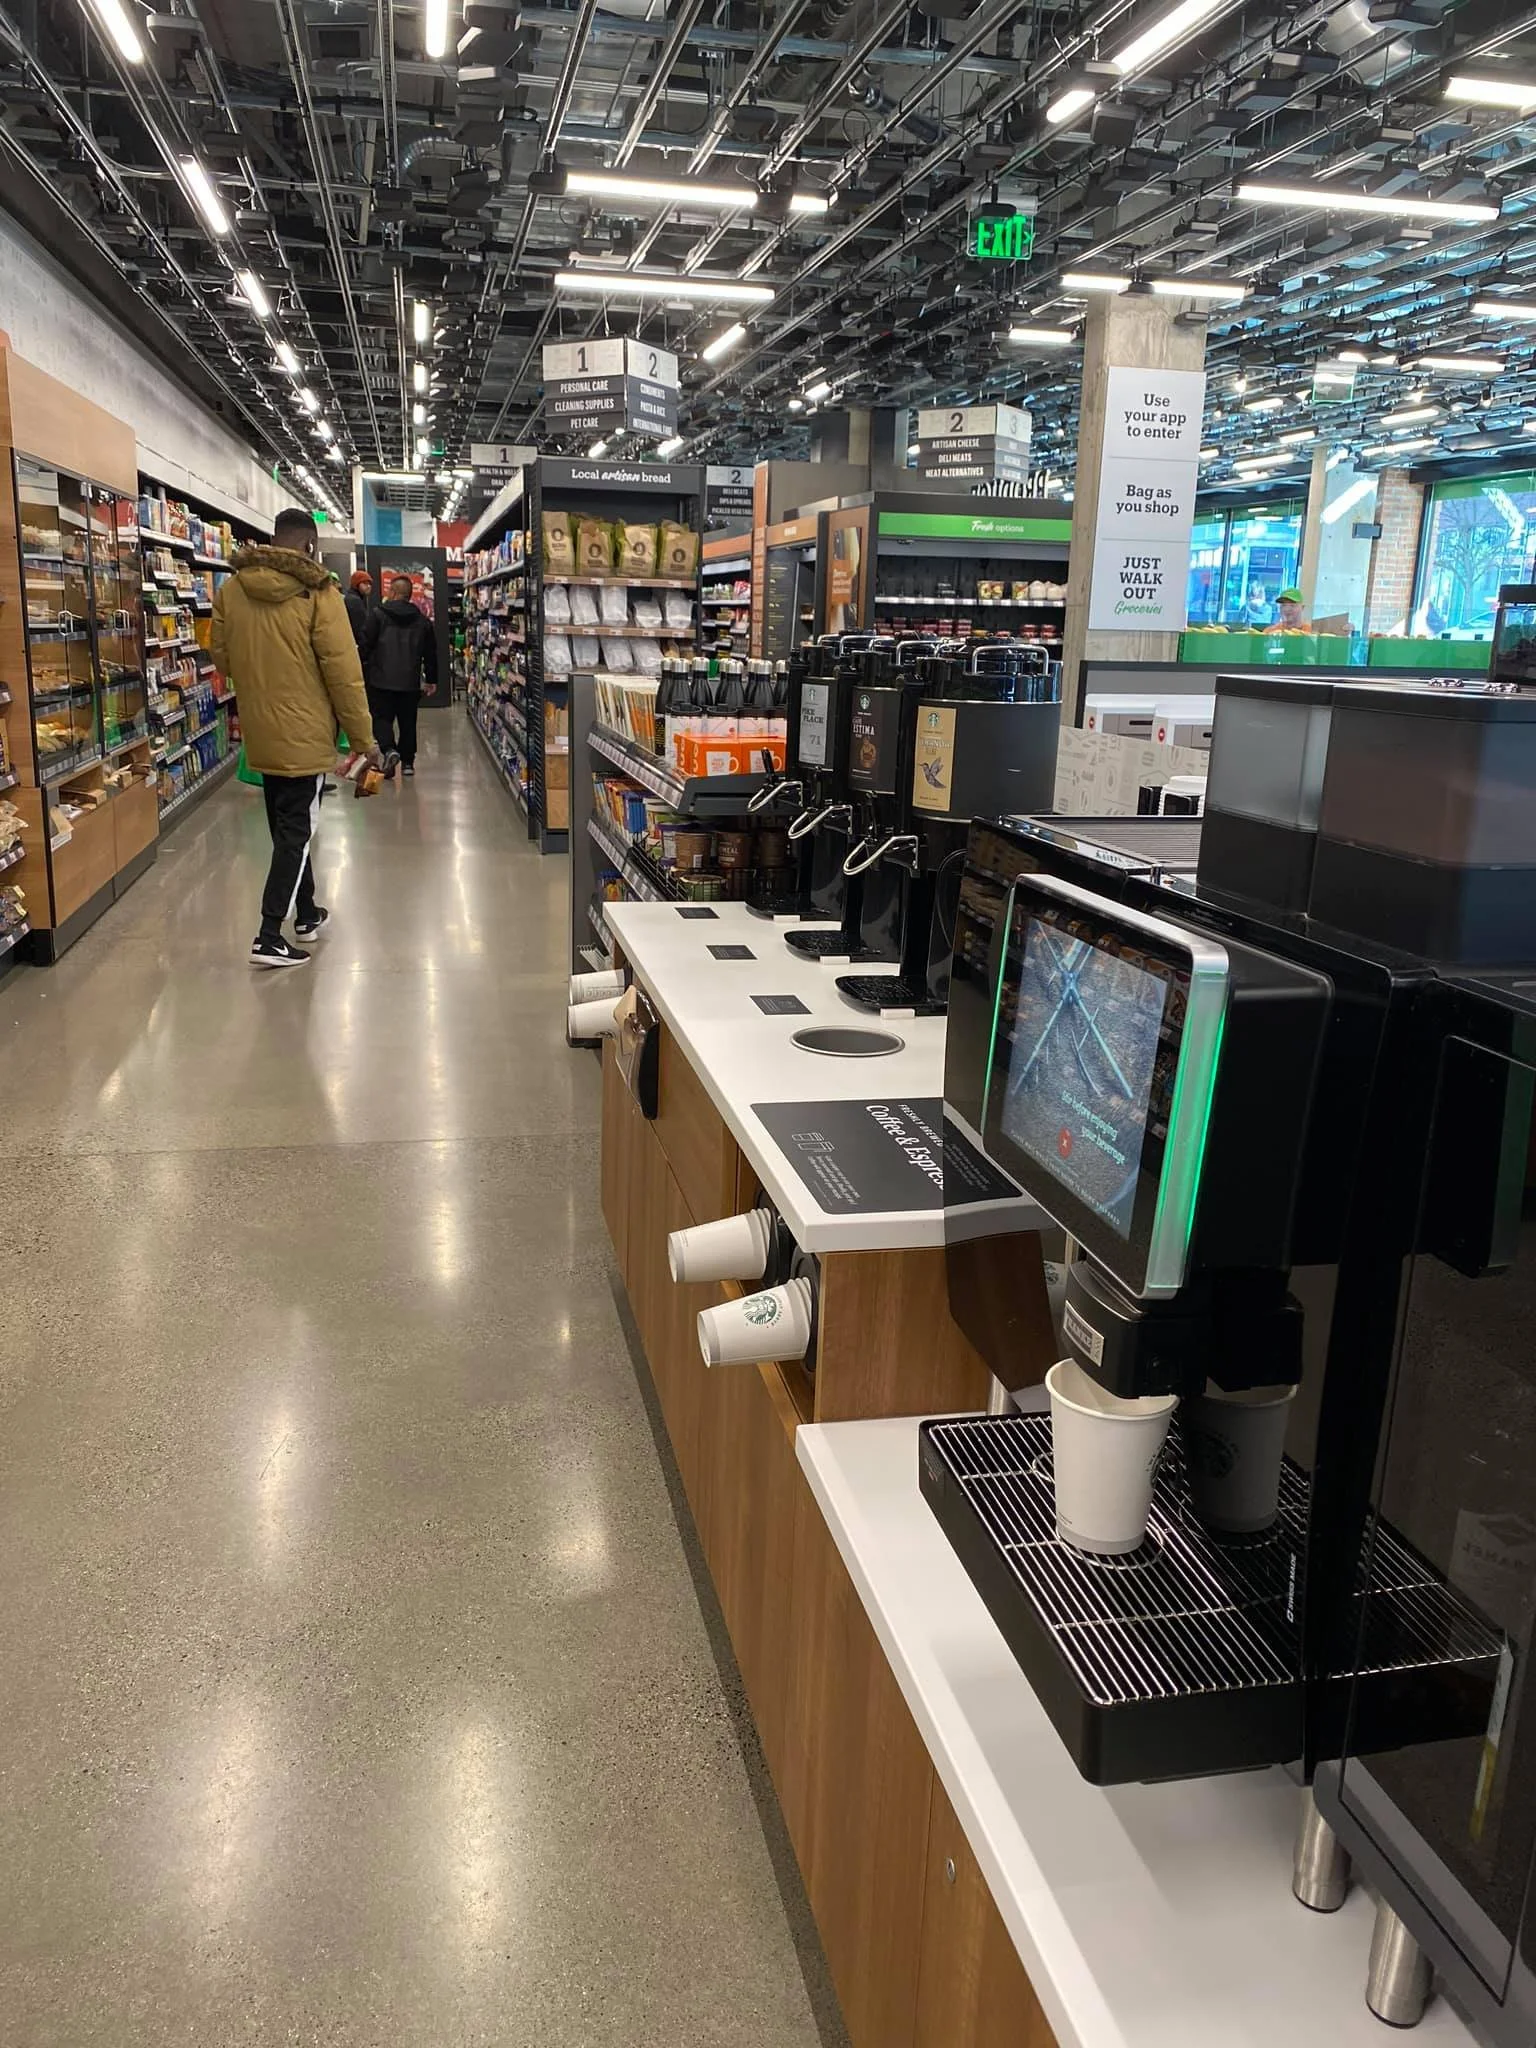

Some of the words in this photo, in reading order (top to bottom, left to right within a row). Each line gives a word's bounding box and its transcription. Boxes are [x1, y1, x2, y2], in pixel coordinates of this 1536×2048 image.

[978, 215, 1026, 257] EXIT
[577, 346, 588, 372] 1
[649, 352, 658, 378] 2
[560, 381, 591, 394] PERSONAL
[592, 380, 608, 392] CARE
[555, 400, 584, 412] CLEANING
[585, 398, 614, 410] SUPPLIES
[1144, 393, 1170, 408] Use
[570, 418, 582, 428] PET
[582, 417, 598, 428] CARE
[950, 412, 964, 433] 2
[1124, 410, 1158, 424] your
[1160, 412, 1186, 426] app
[1127, 424, 1141, 438] to
[1144, 426, 1182, 440] enter
[932, 440, 956, 449] ARTISAN
[958, 438, 980, 448] CHEESE
[500, 448, 510, 464] 1
[938, 454, 952, 464] DELI
[952, 452, 972, 462] MEATS
[572, 468, 600, 480] Local
[601, 468, 640, 482] artisan
[641, 472, 672, 484] bread
[731, 470, 742, 484] 2
[926, 468, 940, 478] MEAT
[942, 466, 984, 478] ALTERNATIVES
[1126, 484, 1154, 500] Bag
[1156, 487, 1172, 498] as
[1116, 502, 1142, 516] you
[1144, 500, 1180, 516] shop
[972, 520, 994, 532] Fresh
[994, 522, 1025, 534] options
[1123, 556, 1162, 570] JUST
[1120, 572, 1164, 586] WALK
[1123, 587, 1156, 600] OUT
[1114, 601, 1162, 616] Groceries
[866, 1104, 906, 1136] Coffee
[898, 1104, 926, 1125] FRESHLY
[920, 1126, 943, 1147] BREWED
[1072, 1095, 1092, 1120] before
[1091, 1113, 1119, 1142] enjoying
[895, 1136, 920, 1146] &
[1096, 1134, 1126, 1165] beverage
[904, 1146, 944, 1190] Espres
